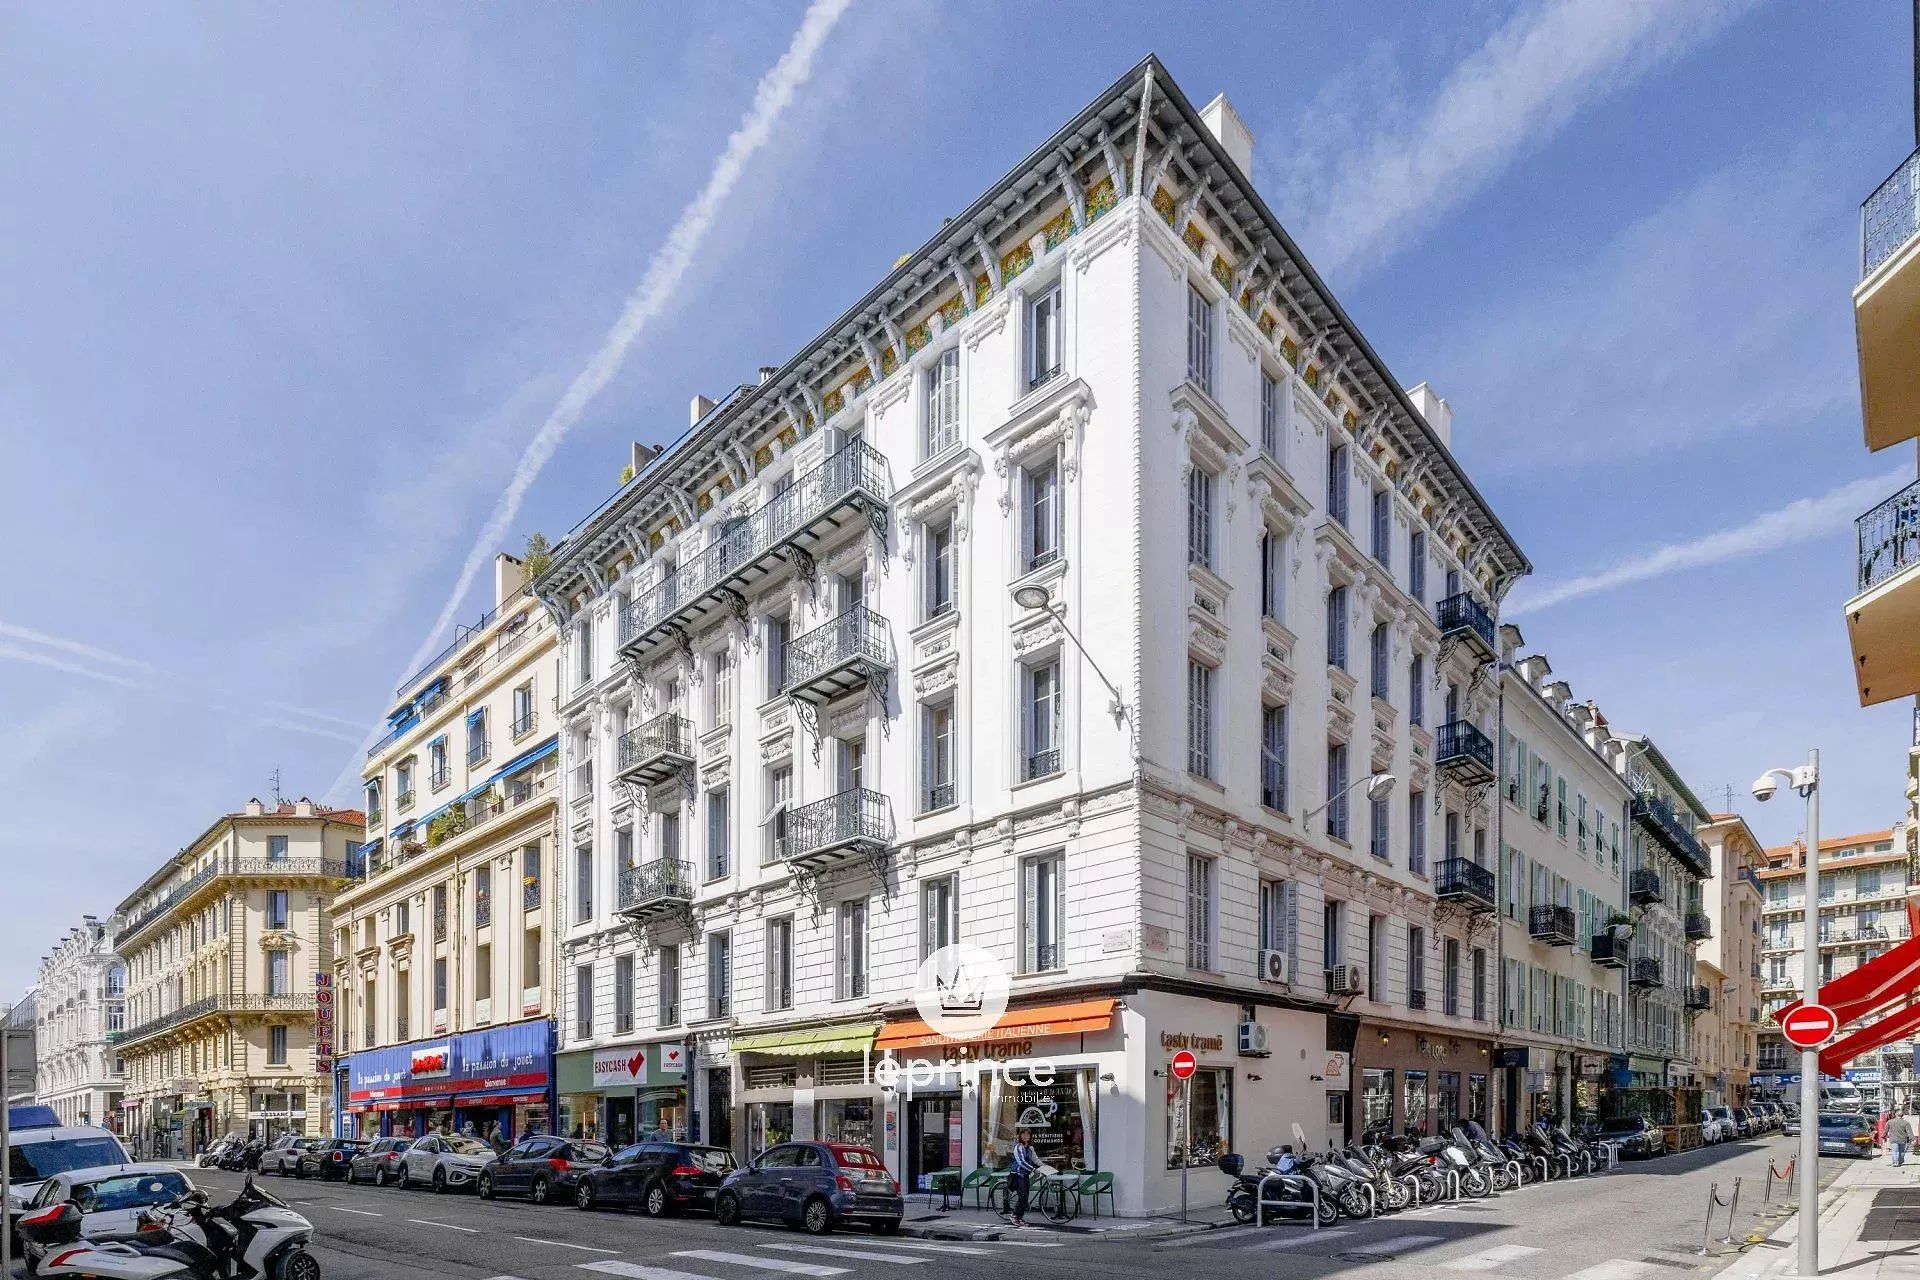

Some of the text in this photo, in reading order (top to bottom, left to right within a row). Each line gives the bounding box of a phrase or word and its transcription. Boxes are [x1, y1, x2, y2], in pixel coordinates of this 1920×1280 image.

[316, 974, 332, 1072] JOUETS
[920, 1024, 1051, 1045] SANDWERIE ITALIENNE
[1161, 1030, 1189, 1051] tasty
[513, 1051, 534, 1071] jouet
[943, 1043, 979, 1061] tasty
[594, 1059, 626, 1074] EASYCASH
